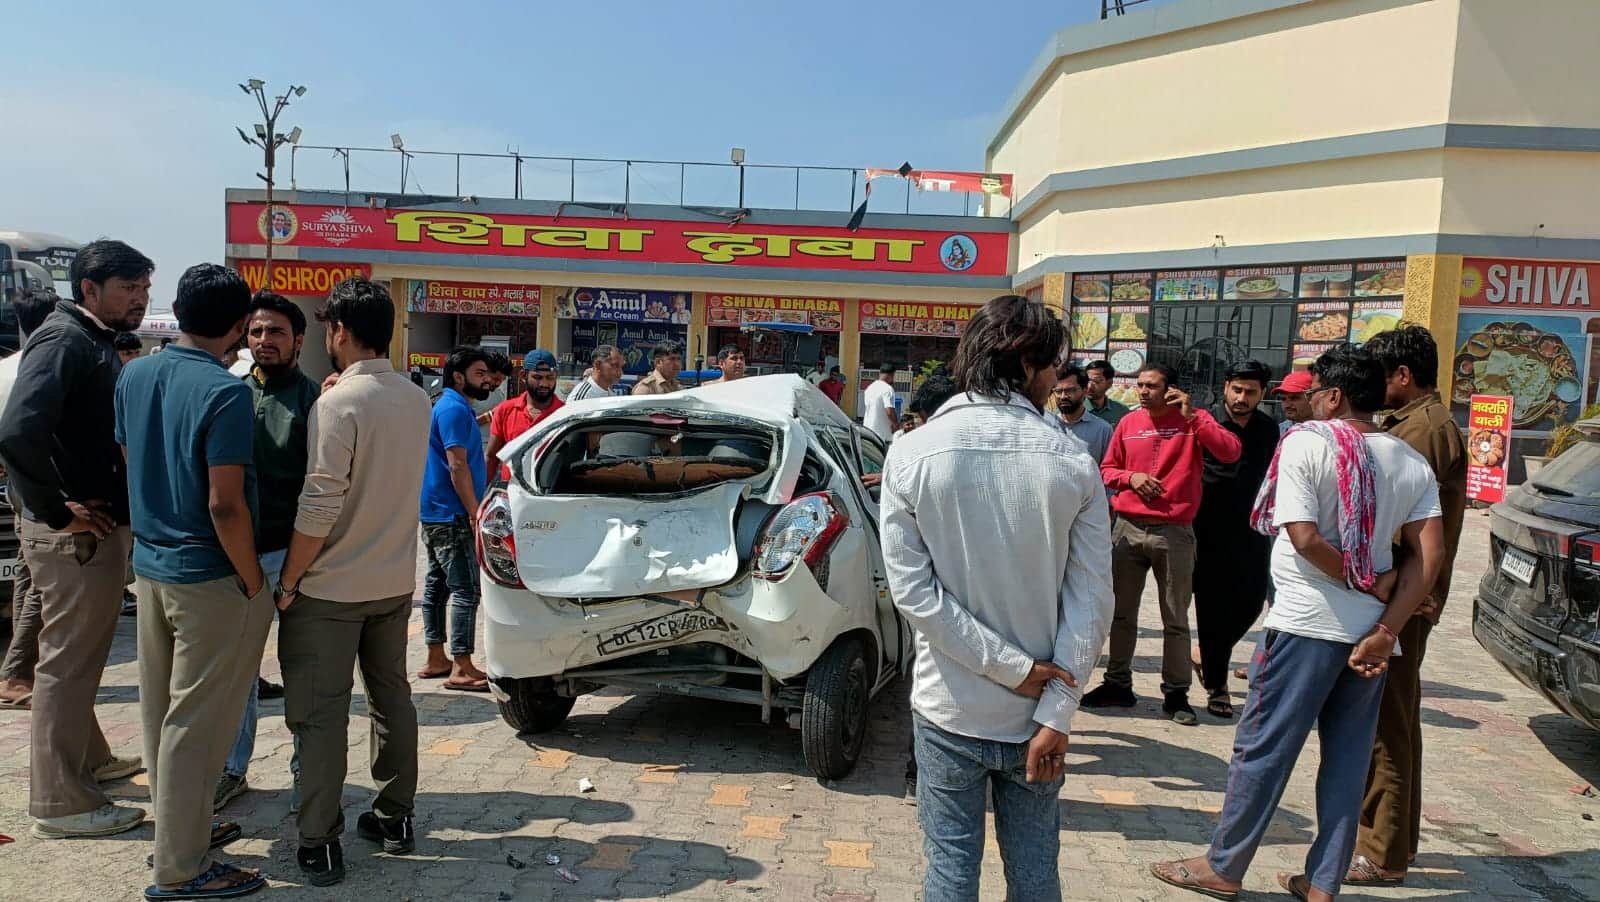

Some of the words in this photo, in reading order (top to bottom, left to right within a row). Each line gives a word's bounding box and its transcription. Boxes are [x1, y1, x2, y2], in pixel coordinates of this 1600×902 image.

[302, 222, 337, 233] SURYA
[339, 223, 373, 233] SHIVA
[386, 211, 654, 252] शिवा
[35, 256, 72, 267] TOU
[1165, 271, 1188, 279] SHIVA
[429, 281, 458, 298] शिवा
[1485, 264, 1590, 305] SHIVA
[594, 290, 646, 311] Amul
[722, 295, 776, 309] SHIVA
[780, 298, 840, 311] DHABA
[600, 311, 612, 319] Ice
[614, 312, 639, 320] Cream
[874, 303, 929, 318] SHIVA
[933, 305, 978, 320] DHA
[622, 328, 644, 339] Amul
